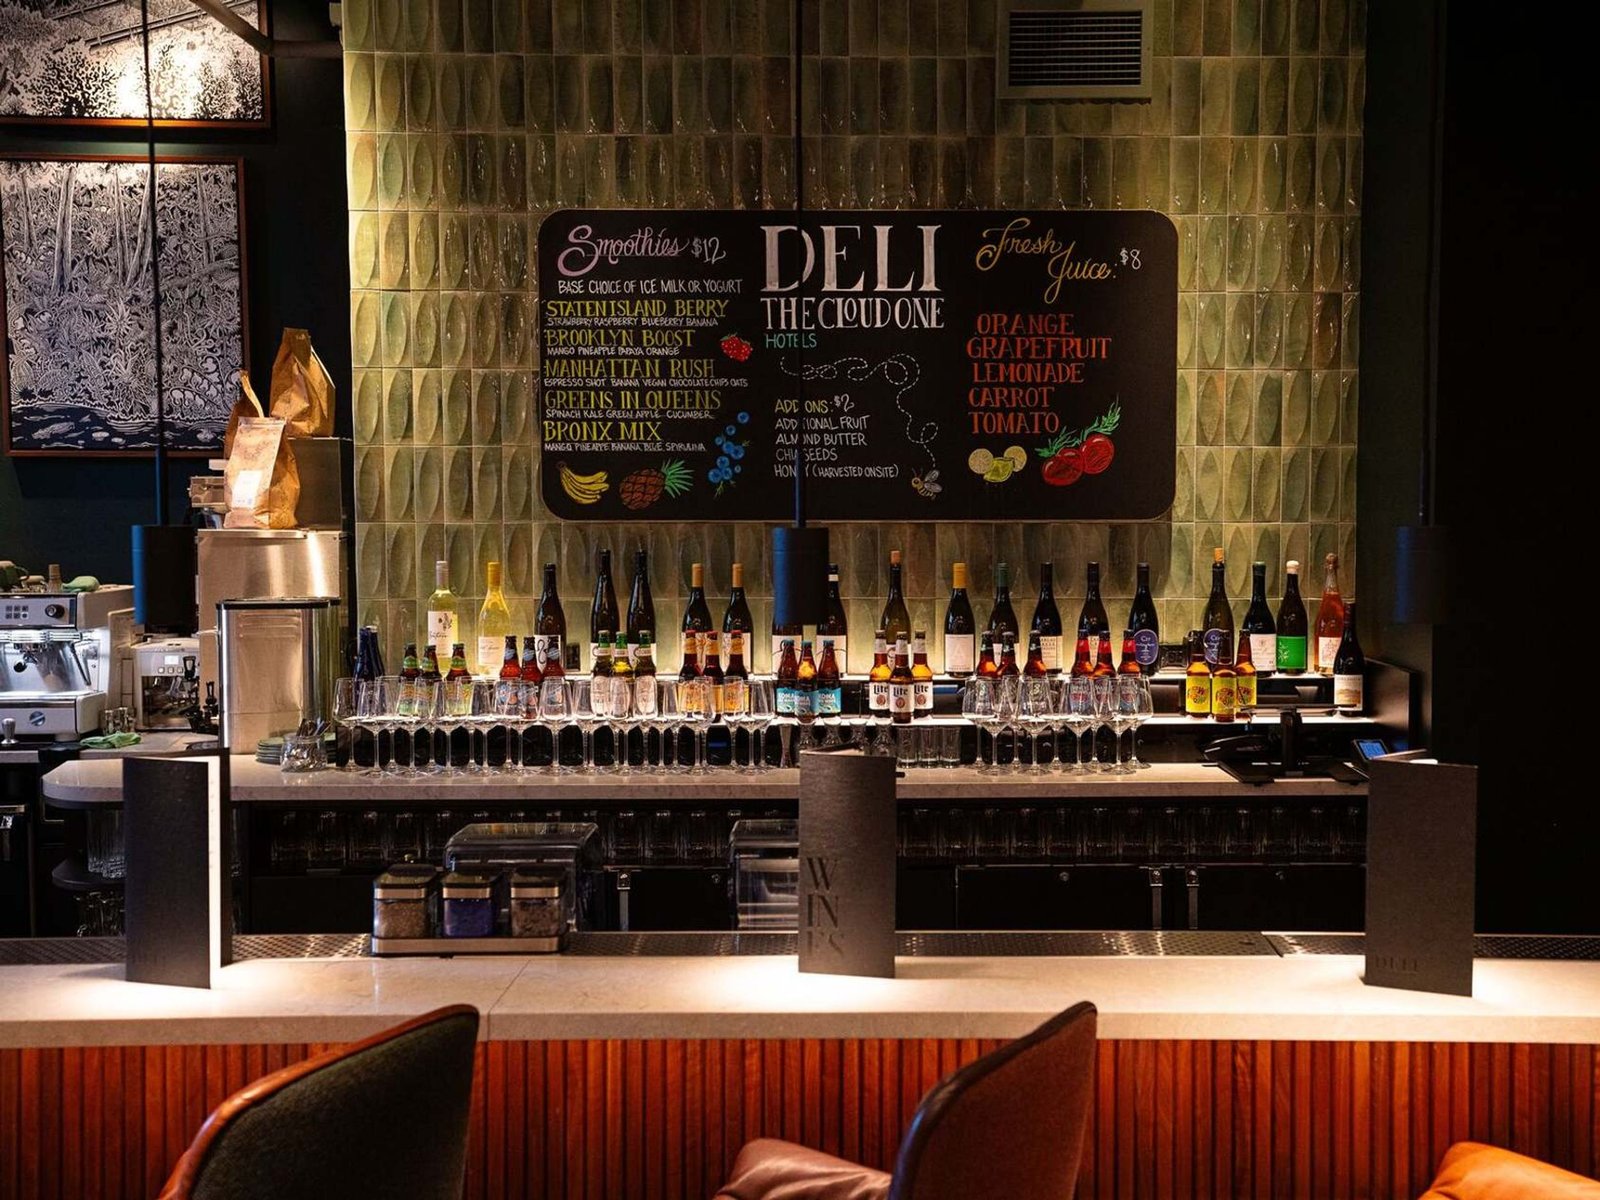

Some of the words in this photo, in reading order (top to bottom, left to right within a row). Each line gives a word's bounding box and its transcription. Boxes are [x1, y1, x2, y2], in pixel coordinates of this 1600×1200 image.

[557, 224, 690, 277] Smoothies
[691, 236, 727, 265] $12
[976, 217, 1063, 271] Fresh
[760, 224, 942, 292] DELI
[1119, 247, 1142, 270] $8
[558, 280, 585, 294] BASE
[588, 280, 622, 294] CHOICE
[623, 280, 637, 293] OF
[640, 279, 658, 294] ICE
[660, 280, 688, 294] MILK
[688, 280, 701, 293] OR
[702, 279, 743, 294] YOGURT
[674, 300, 729, 318] BERRY
[760, 298, 816, 330] THE
[817, 297, 892, 330] CLOUD
[894, 297, 945, 330] ONE
[547, 317, 593, 327] STRAWBERRY
[594, 317, 639, 327] RASPBERRY
[641, 317, 685, 327] BLUEBERRY
[686, 318, 719, 327] BANANA
[975, 314, 1075, 335] ORANGE
[546, 329, 635, 347] BROOKLYN
[642, 329, 696, 347] BOOST
[765, 333, 817, 349] HOTELS
[547, 347, 575, 355] MANGO
[578, 346, 616, 355] PINEAPPLE
[646, 347, 680, 355] ORANGE
[966, 337, 1112, 359] GRAPEFRUIT
[545, 359, 660, 378] MANHATTAN
[669, 359, 716, 378] RUSH
[973, 362, 1085, 383] LEMONADE
[544, 378, 584, 387] ESPRESSO
[585, 378, 606, 387] SHOT
[611, 378, 640, 387] BANANA
[643, 379, 667, 387] VEGAN
[730, 379, 749, 387] OATS
[545, 390, 614, 409] GREENS
[620, 391, 640, 409] IN
[645, 390, 722, 410] QUEENS
[834, 394, 855, 412] $2
[968, 387, 1055, 407] CARROT
[546, 409, 581, 418] SPINACH
[583, 410, 604, 418] KALE
[605, 410, 633, 418] GREEN
[635, 410, 660, 419] APPLE
[666, 410, 715, 419] CUCUMBER
[839, 415, 871, 430] FRUIT
[968, 411, 1060, 434] TOMATO
[543, 421, 613, 441] BRONX
[618, 422, 663, 441] MIX
[824, 433, 868, 446] BUTTER
[544, 443, 573, 451] MANGO
[611, 443, 641, 451] BANANA
[802, 448, 838, 462] SEEDS
[774, 464, 810, 478] HONY
[893, 686, 908, 697] Lite
[806, 857, 840, 891] W
